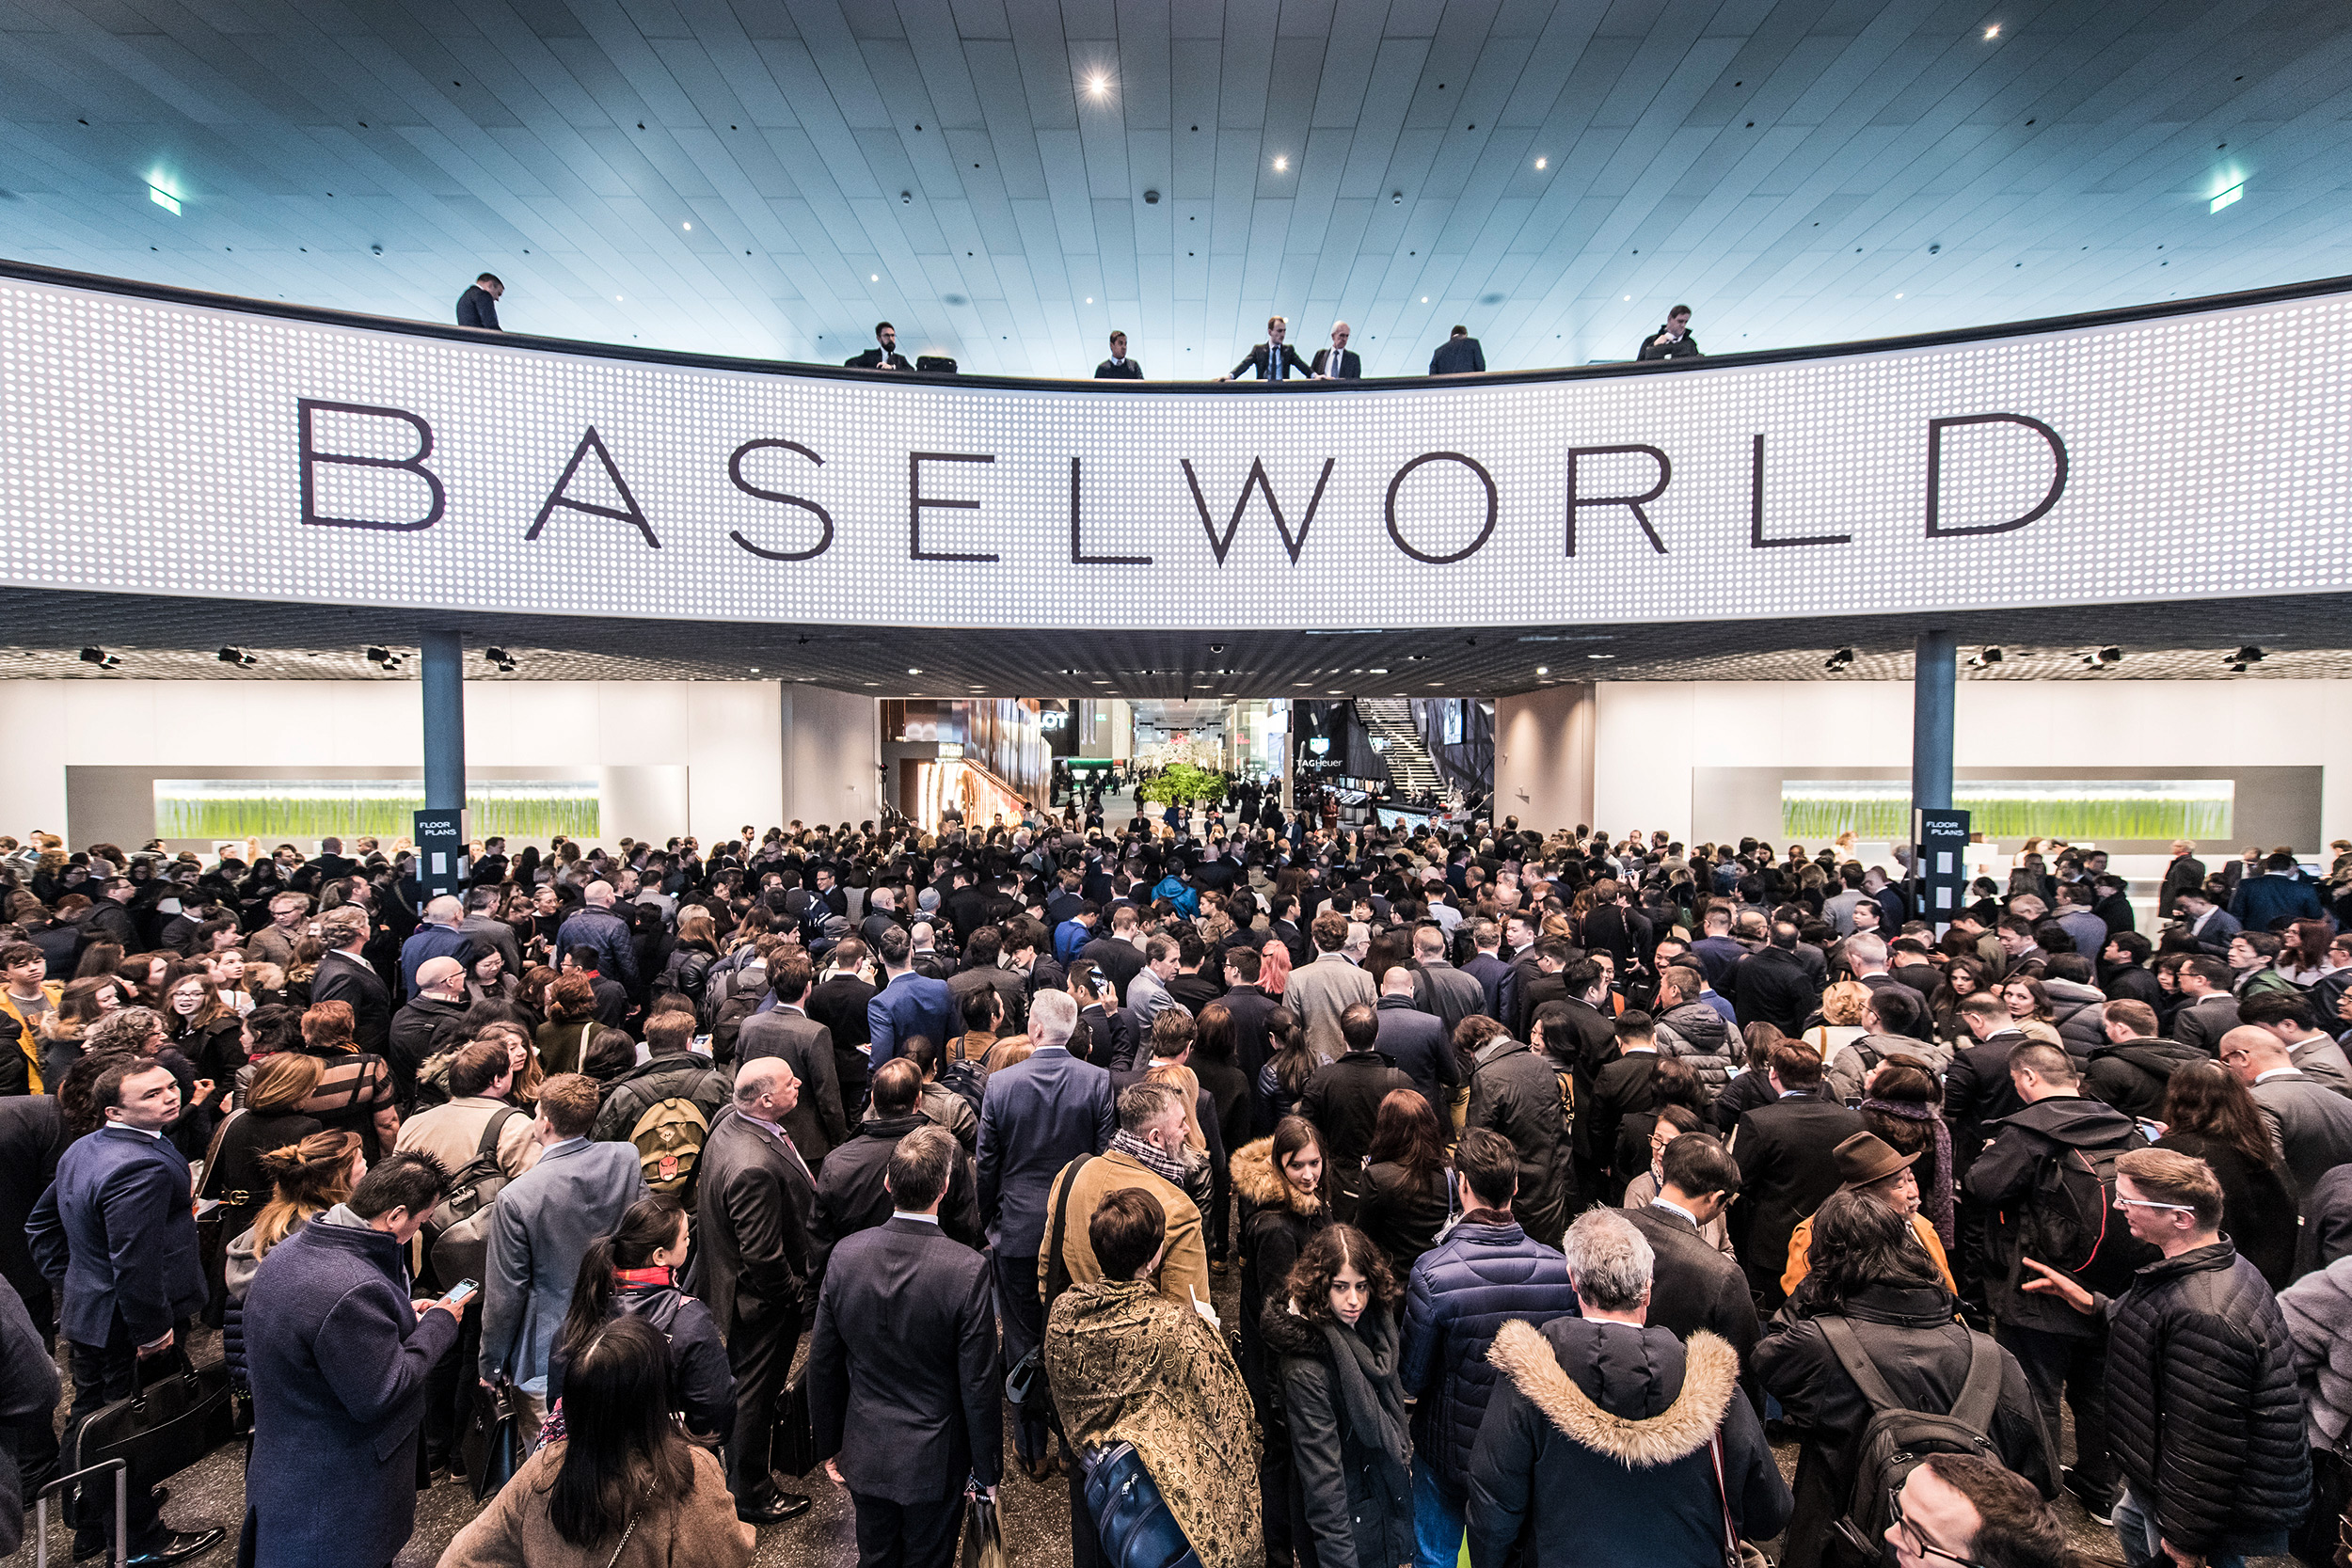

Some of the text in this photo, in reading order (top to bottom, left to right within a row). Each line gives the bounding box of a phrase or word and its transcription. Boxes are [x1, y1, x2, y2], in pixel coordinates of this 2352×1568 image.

[295, 396, 2071, 571] BASELWORLD
[1040, 712, 1069, 730] OT
[419, 821, 451, 830] FLOOR
[1925, 820, 1959, 829] FLOOR
[1931, 829, 1965, 837] PLANS
